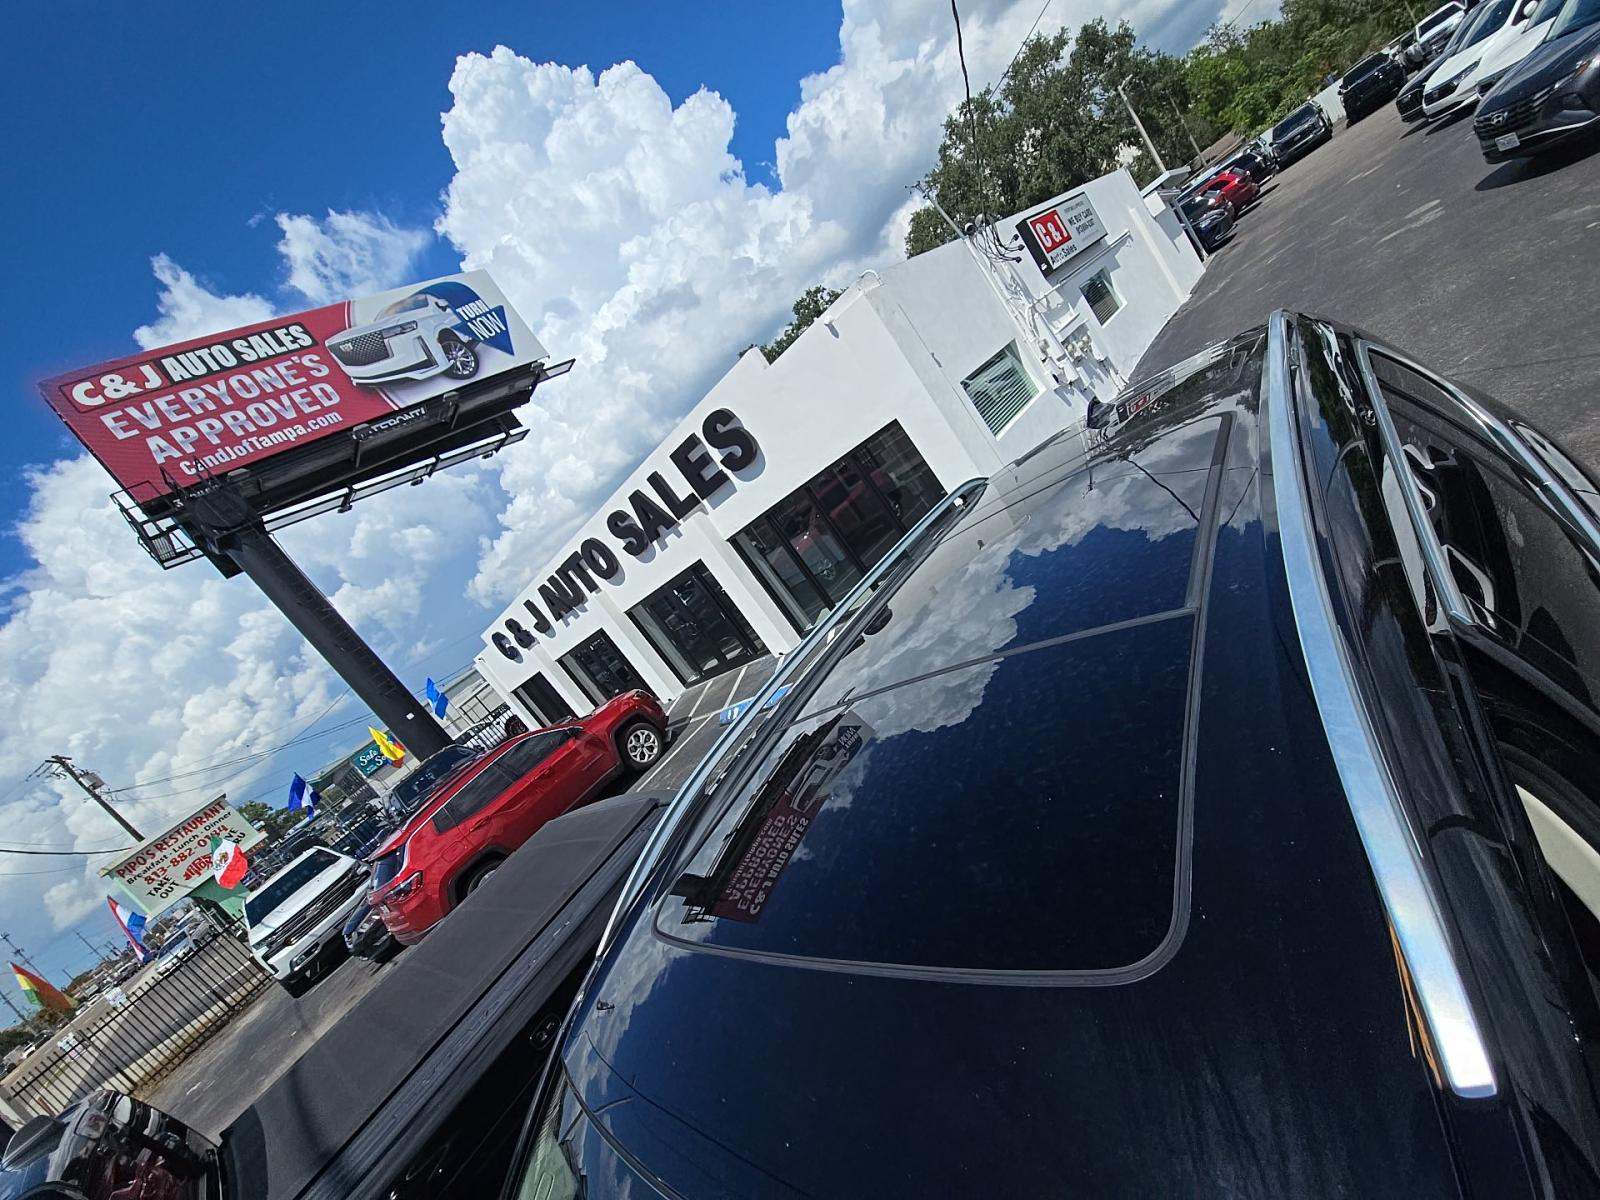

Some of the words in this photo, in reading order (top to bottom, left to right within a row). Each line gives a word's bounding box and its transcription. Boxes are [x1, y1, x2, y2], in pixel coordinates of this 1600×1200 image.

[1036, 214, 1068, 248] C&J
[1062, 244, 1077, 259] Sales
[455, 299, 490, 321] TURN
[467, 311, 507, 341] NOW
[161, 344, 238, 383] AUTO
[232, 324, 313, 362] SALES
[100, 353, 330, 441] EVERYONE'S
[146, 382, 341, 465] APPROVED
[179, 411, 344, 476] CandJofTampa.com
[537, 537, 622, 623] AUTO
[606, 407, 759, 557] SALES
[116, 848, 156, 878] PIPO'S
[155, 801, 226, 853] RESTAURANT
[127, 853, 169, 885] Breakfast
[173, 834, 199, 854] Lunch
[203, 810, 232, 832] Dinner
[147, 874, 173, 898] TAKE
[160, 880, 180, 899] OUT
